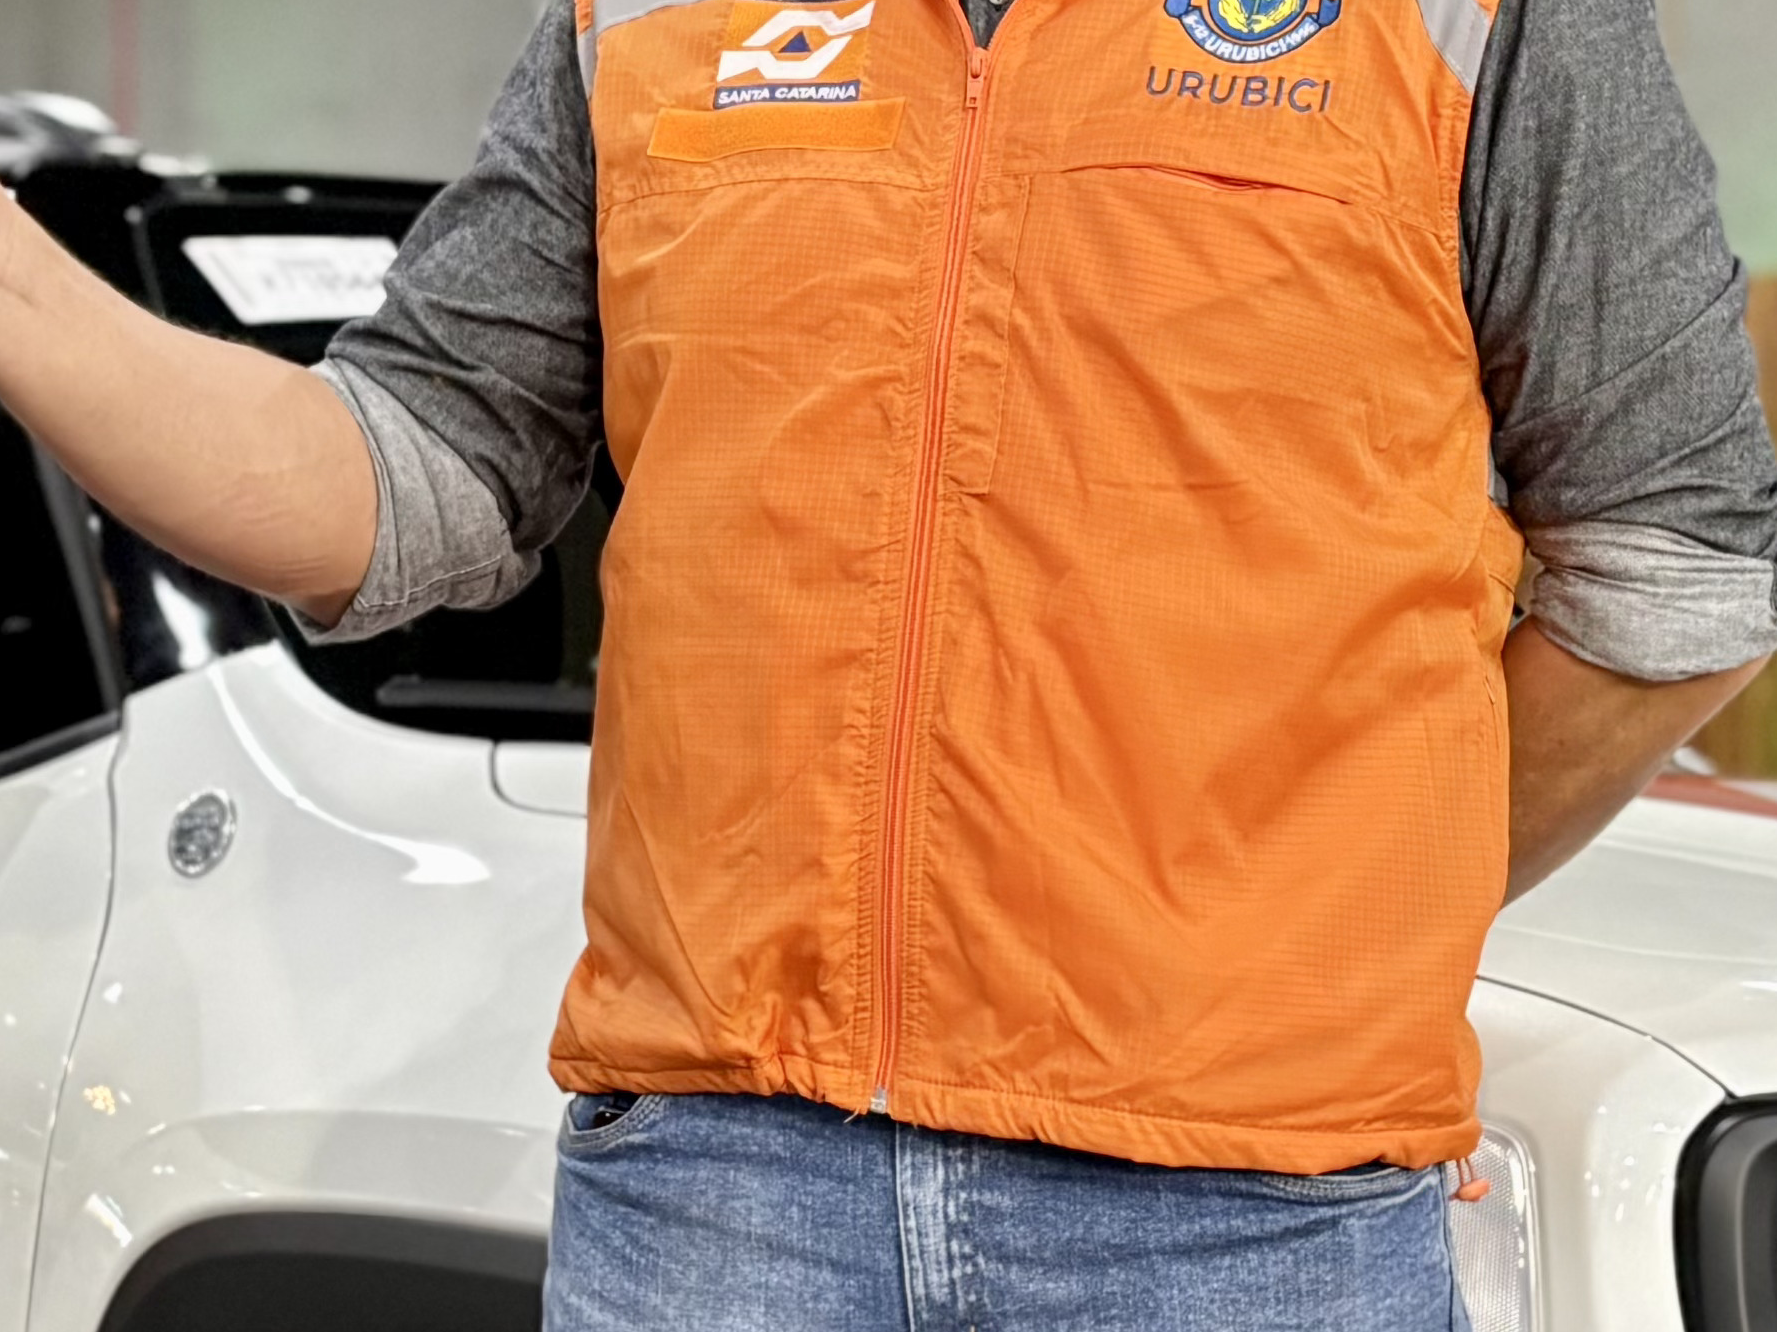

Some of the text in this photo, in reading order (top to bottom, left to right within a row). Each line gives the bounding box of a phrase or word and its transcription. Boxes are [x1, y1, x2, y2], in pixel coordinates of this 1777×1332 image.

[1203, 33, 1287, 63] URUBICI
[717, 84, 857, 105] SANTA CATARINA
[1145, 65, 1331, 113] URUBICI
